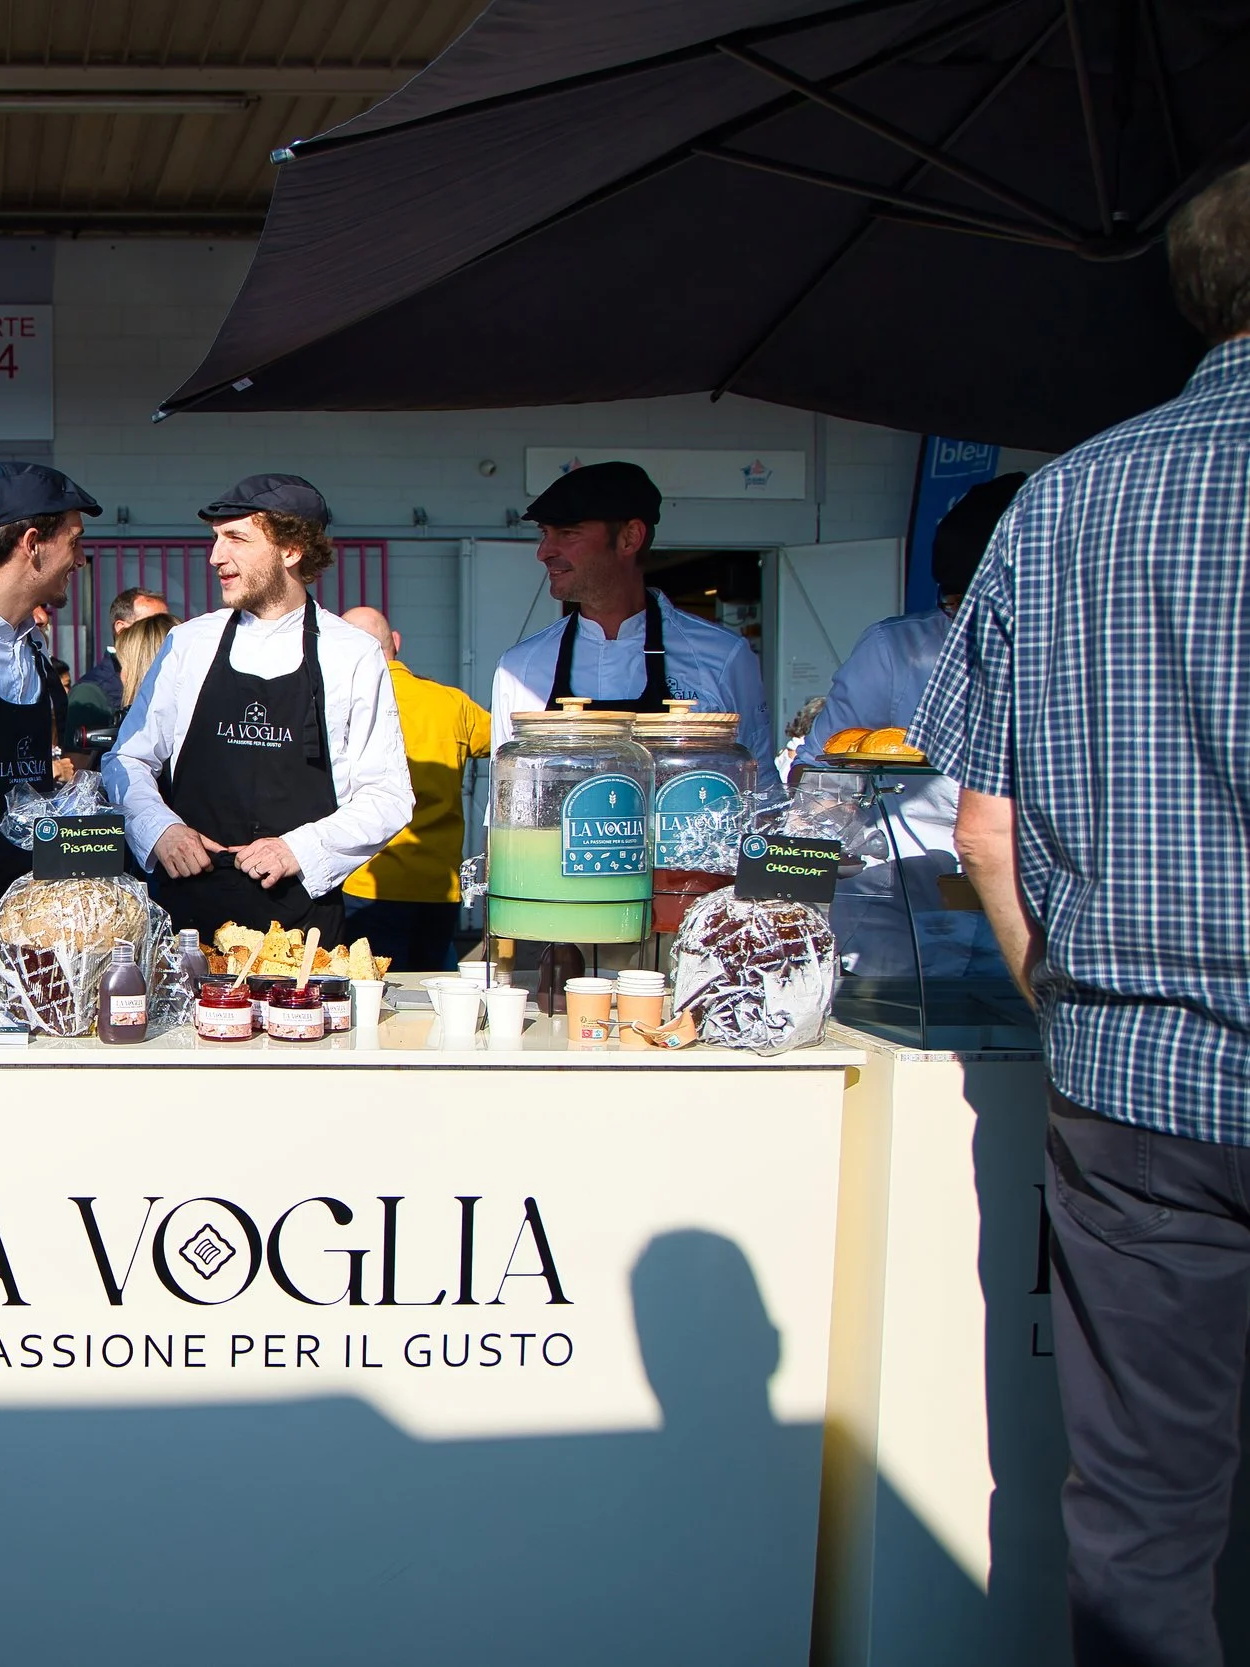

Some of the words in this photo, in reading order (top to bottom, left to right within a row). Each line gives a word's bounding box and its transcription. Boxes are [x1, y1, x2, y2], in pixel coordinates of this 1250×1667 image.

[939, 440, 989, 463] bleu
[217, 722, 235, 737] LA
[238, 724, 293, 742] VOGLIA
[59, 826, 125, 838] PANETTONE
[571, 822, 592, 837] LA
[595, 821, 643, 837] VOGLIA
[662, 817, 681, 831] LA
[766, 844, 841, 861] PANETTONE
[766, 863, 828, 876] CHOCOLAT
[67, 1196, 574, 1306] VOGLIA
[231, 1334, 320, 1367] PER
[345, 1334, 383, 1367] IL
[402, 1332, 575, 1368] GUSTO
